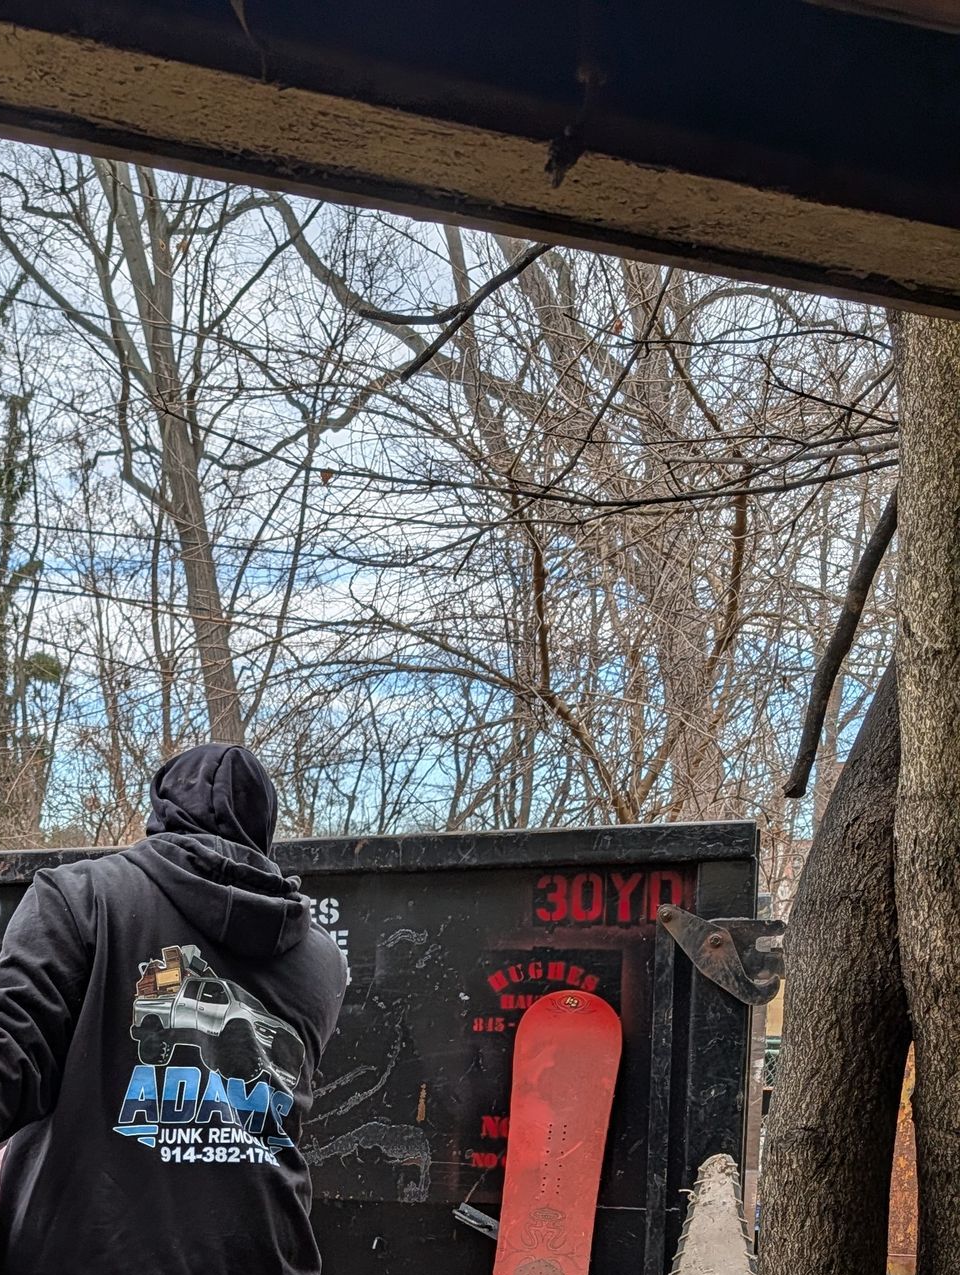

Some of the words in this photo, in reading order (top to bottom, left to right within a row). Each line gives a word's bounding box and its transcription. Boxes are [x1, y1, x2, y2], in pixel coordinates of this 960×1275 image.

[487, 960, 600, 992] HUGHES
[118, 1065, 294, 1135] ADAMS
[159, 1128, 205, 1145] JUNK
